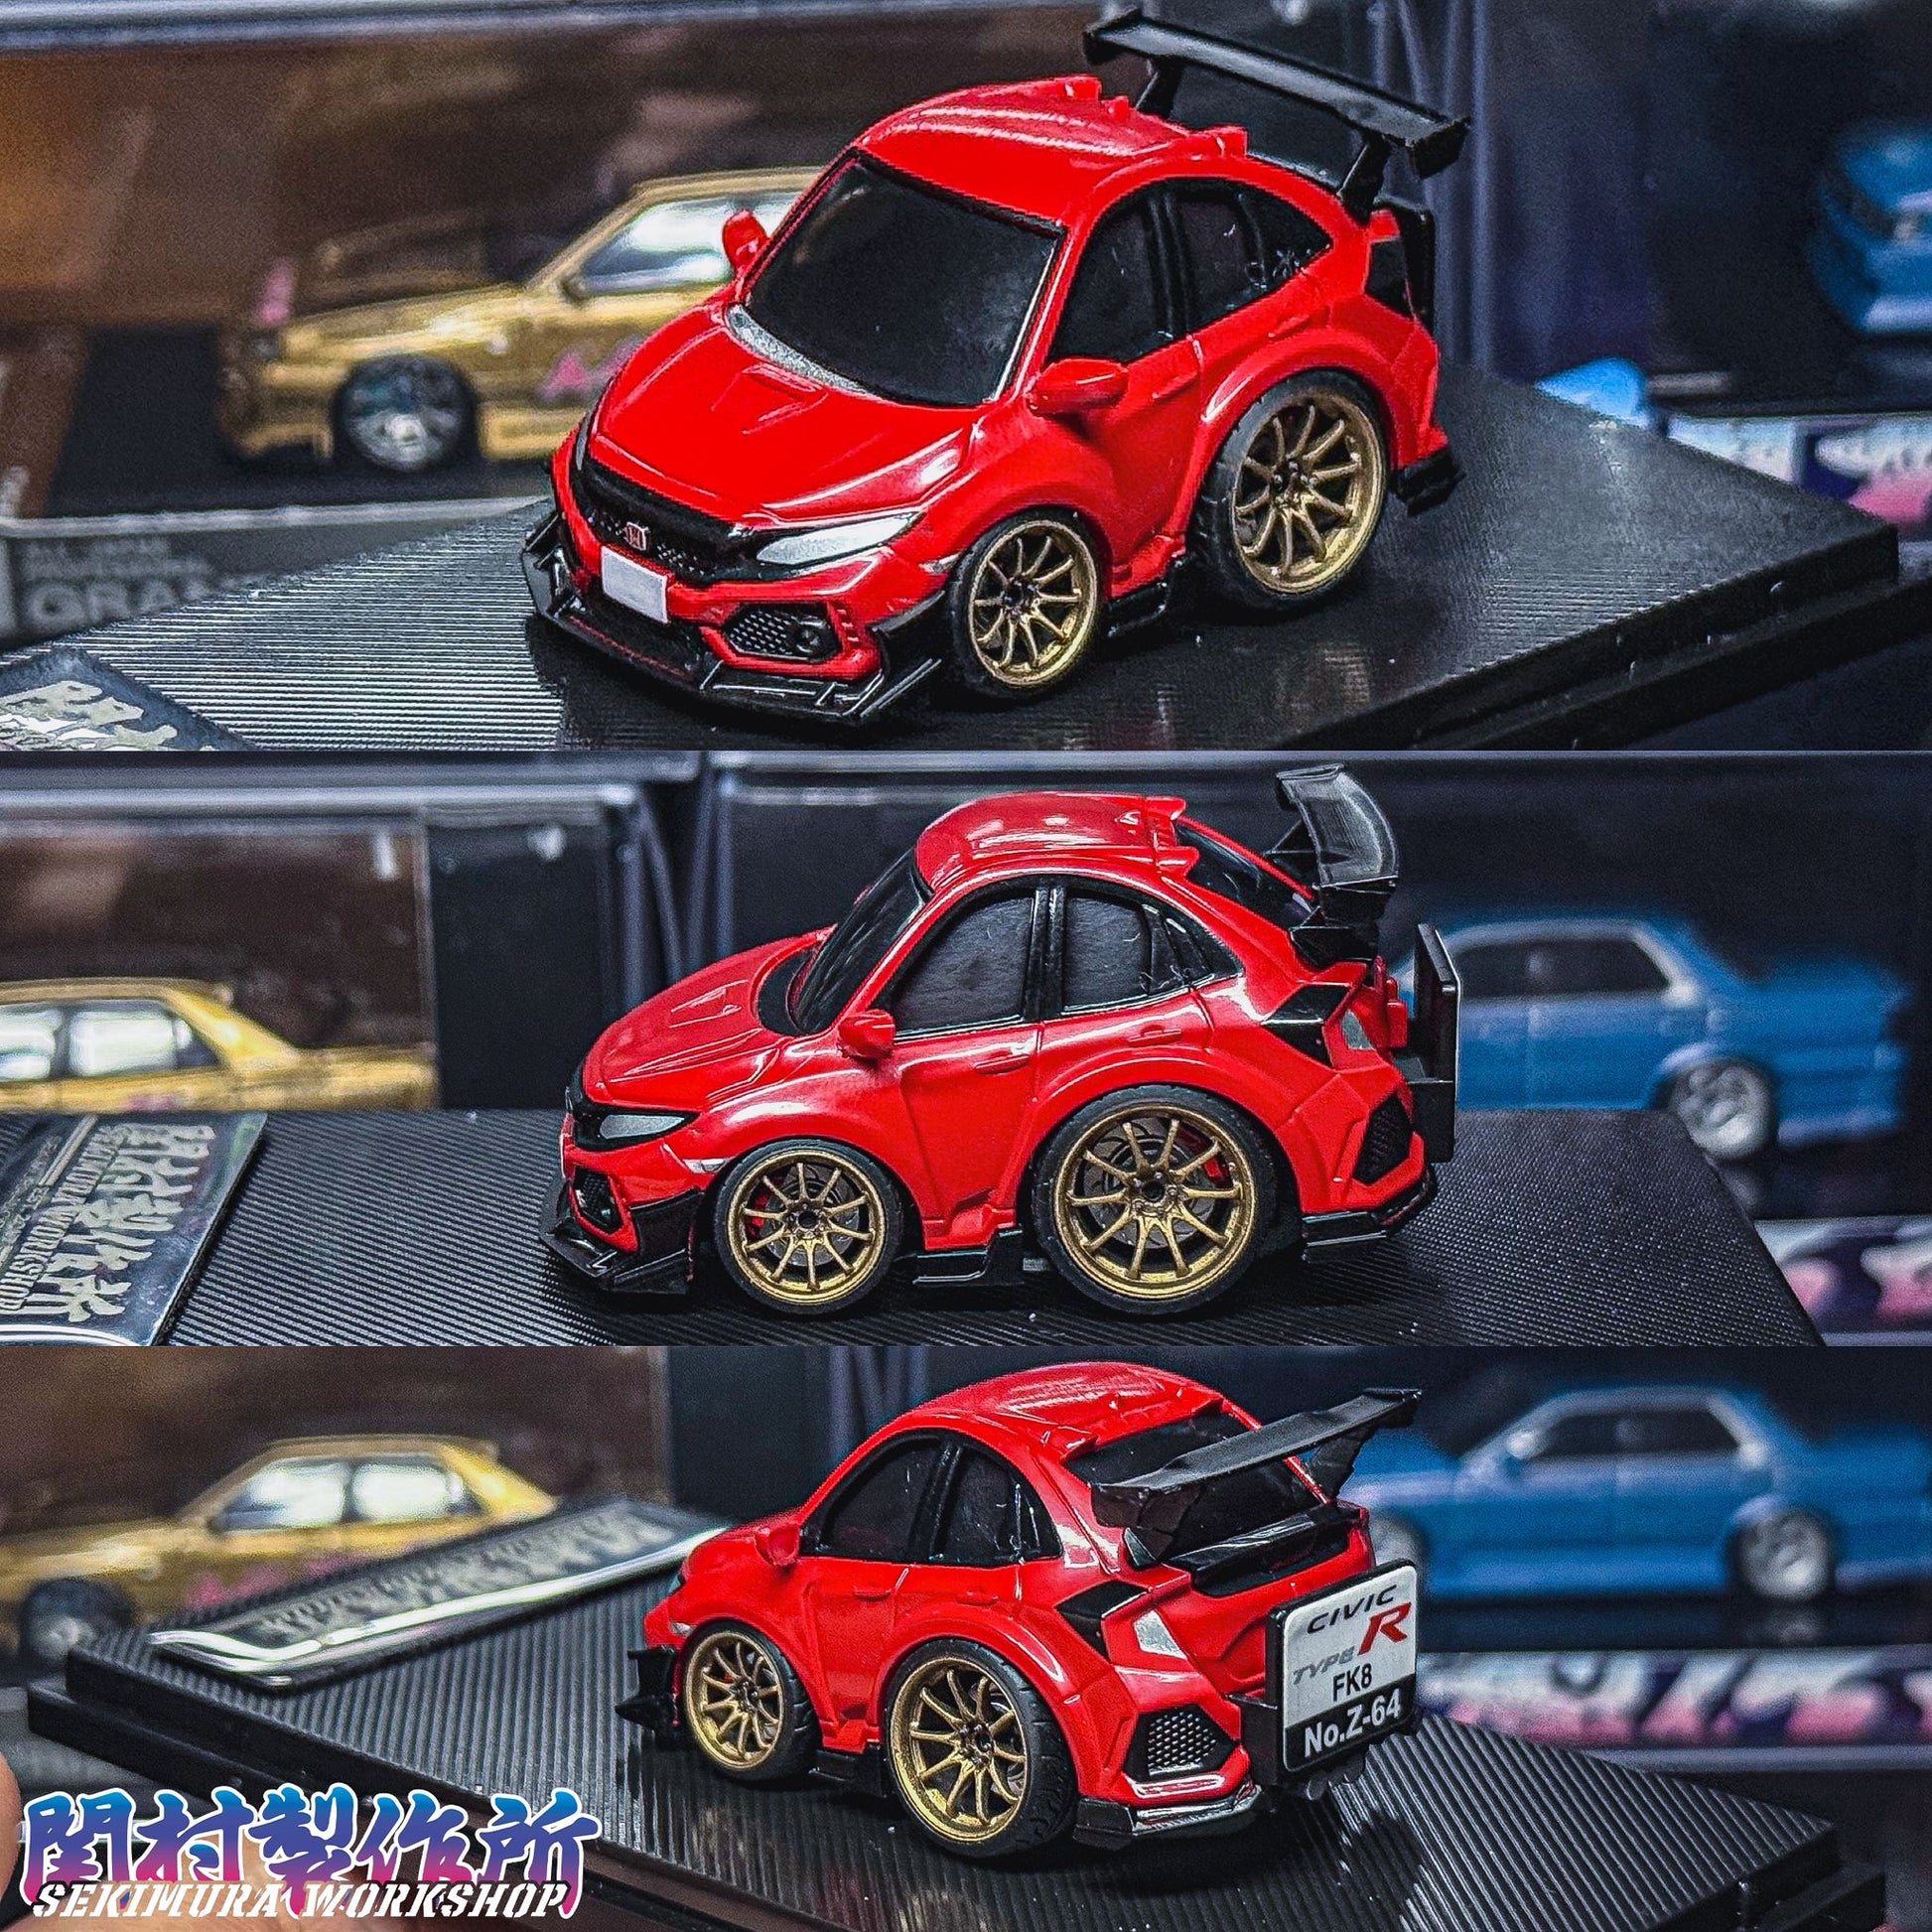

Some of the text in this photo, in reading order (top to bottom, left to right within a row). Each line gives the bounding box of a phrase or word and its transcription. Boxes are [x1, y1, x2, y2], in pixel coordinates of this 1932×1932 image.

[1308, 1585, 1397, 1634] CIVIC
[1293, 1601, 1412, 1685] TYPE R
[1332, 1663, 1372, 1702] FK8
[1305, 1688, 1401, 1757] No.Z-64
